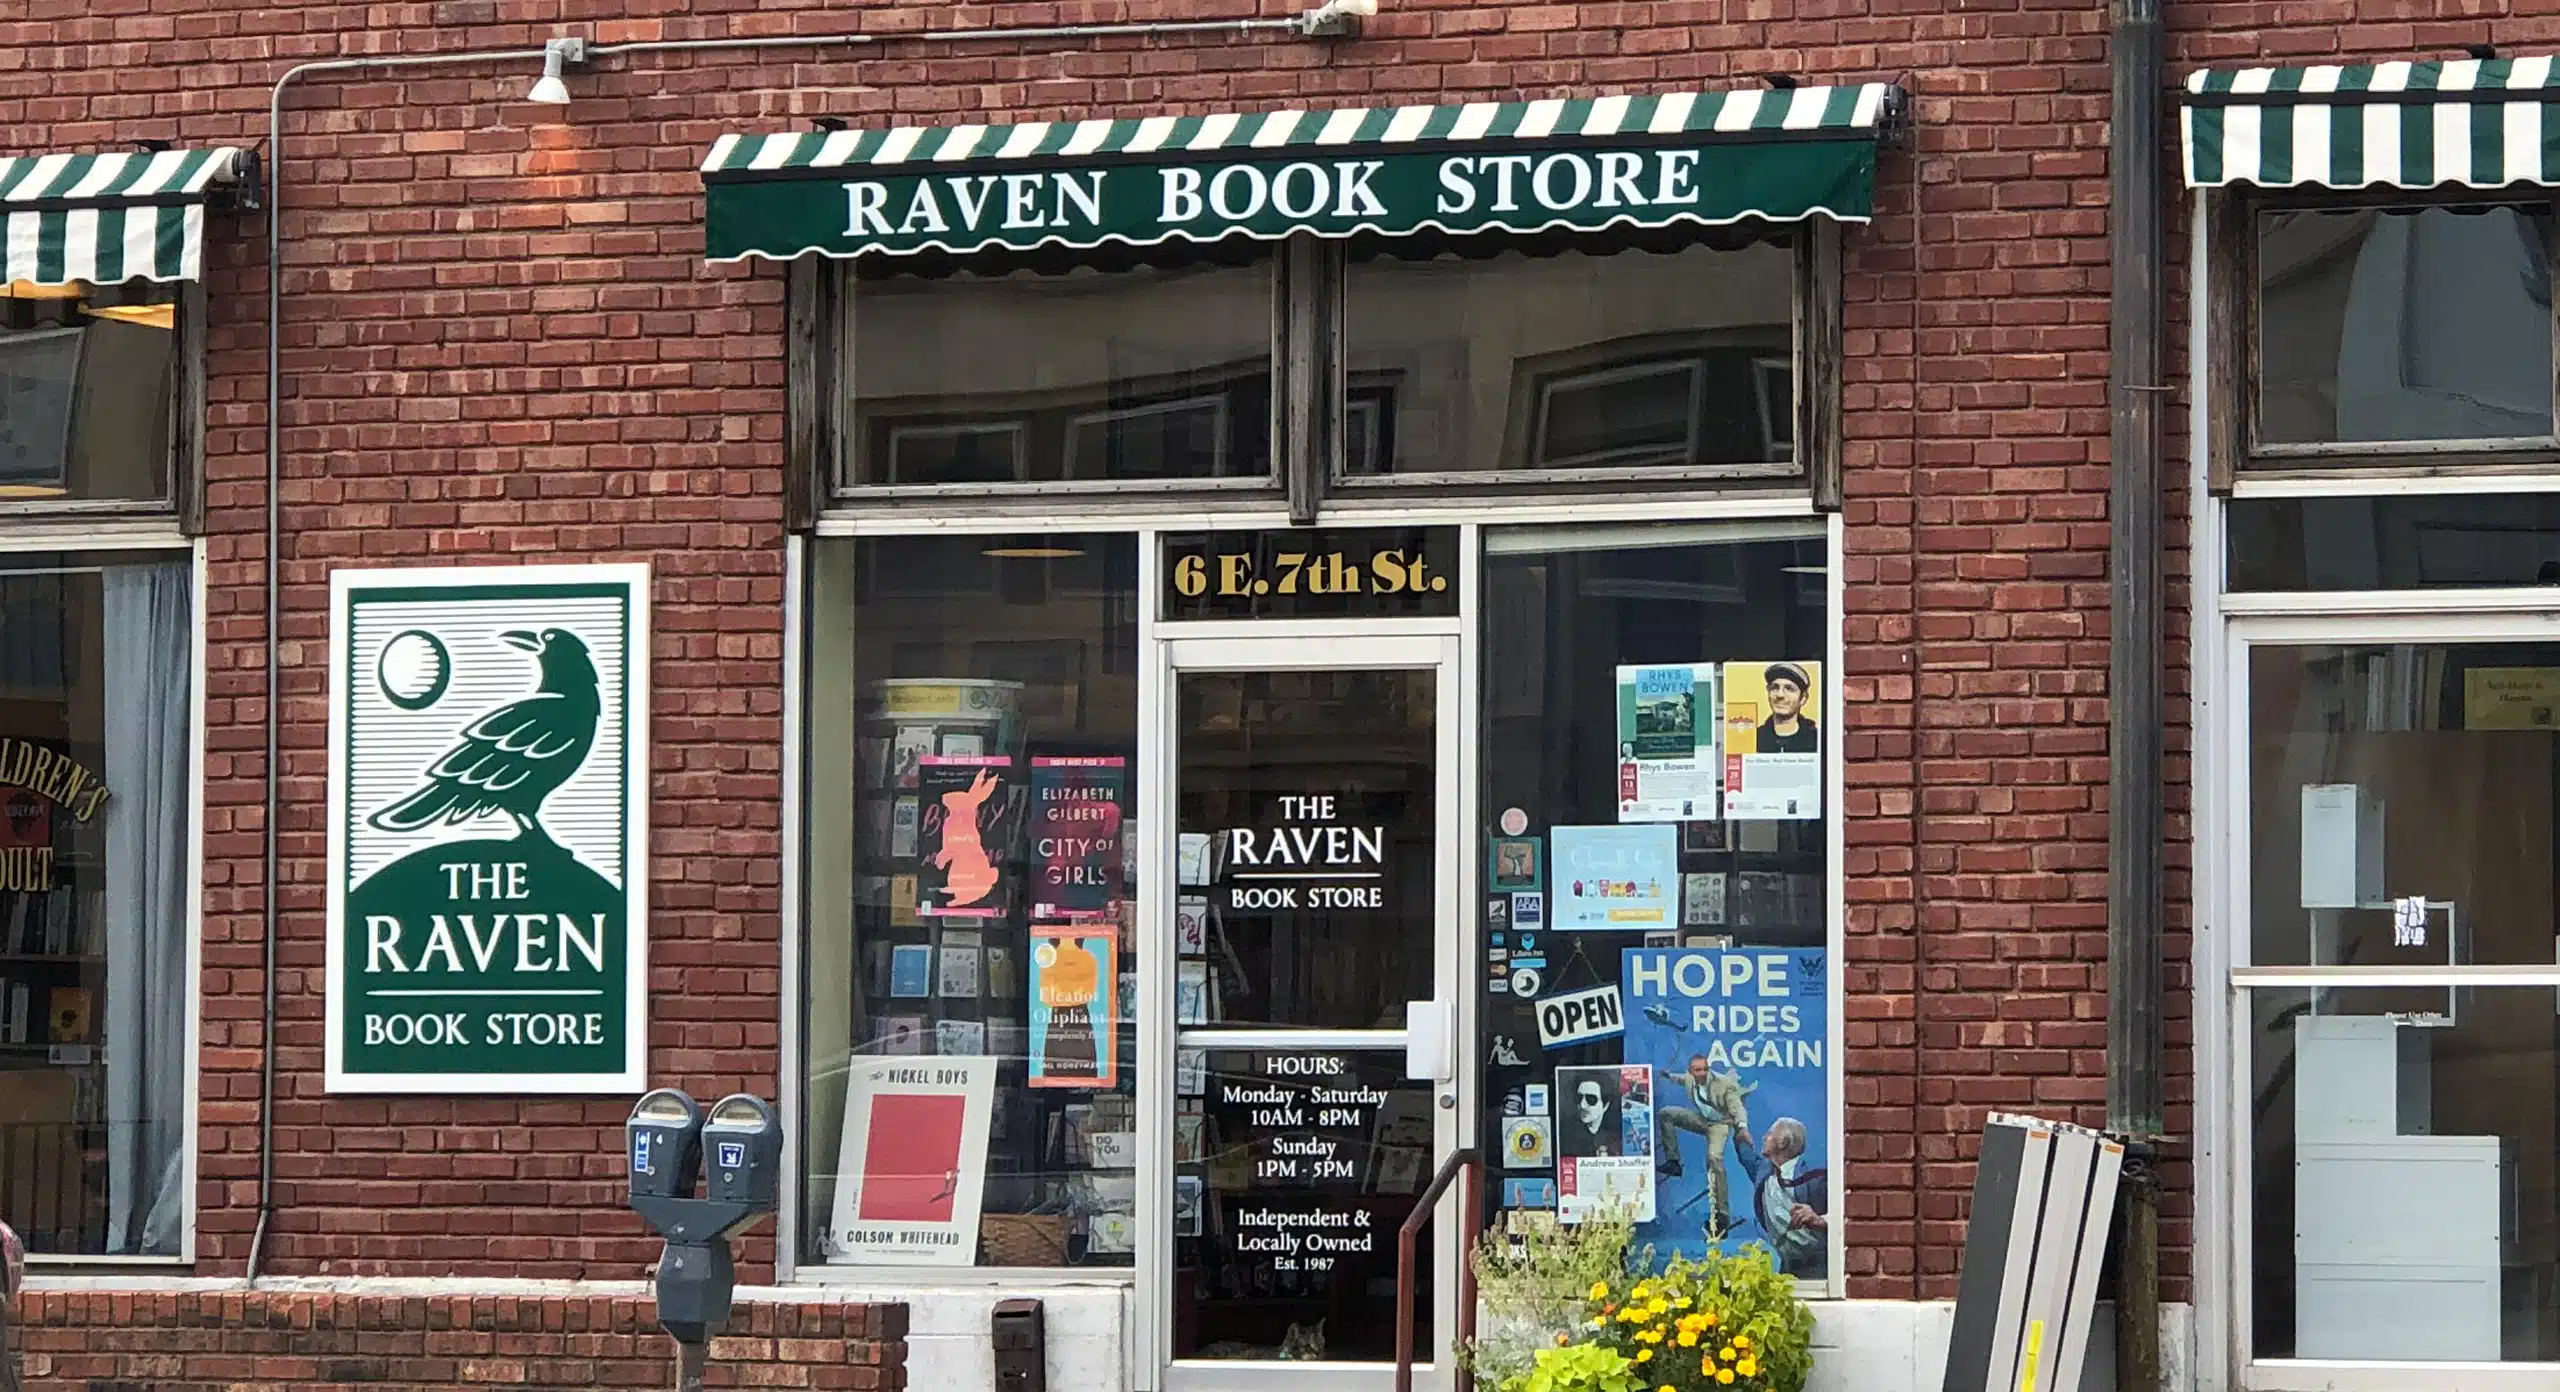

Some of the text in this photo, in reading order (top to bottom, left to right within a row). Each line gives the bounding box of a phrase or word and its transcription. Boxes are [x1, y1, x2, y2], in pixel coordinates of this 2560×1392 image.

[842, 149, 1700, 237] RAVEN BOOK STORE
[1174, 555, 1207, 596] 6
[1275, 552, 1361, 594] 7th
[1371, 548, 1446, 595] St.
[1649, 669, 1681, 680] RHYS
[1642, 682, 1688, 693] BOWEN
[1042, 787, 1114, 800] ELIZABETH
[1047, 807, 1106, 820] GILBERT
[1278, 796, 1337, 820] THE
[1038, 838, 1090, 857] CITY
[1231, 826, 1384, 865] RAVEN
[439, 862, 530, 899] THE
[1046, 866, 1108, 885] GIRLS
[1231, 887, 1383, 909] BOOK STORE
[364, 913, 606, 973] RAVEN
[1632, 954, 1790, 998] HOPE
[1039, 986, 1098, 1003] Eleanor
[1543, 992, 1619, 1038] OPEN
[1693, 1005, 1801, 1033] RIDES
[364, 1012, 605, 1045] BOOK STORE
[1708, 1039, 1822, 1068] AGAIN
[1266, 1056, 1345, 1075] HOURS:
[888, 1069, 930, 1084] NICKEL
[936, 1070, 968, 1084] BOYS
[1223, 1085, 1295, 1108] Monday
[1310, 1085, 1389, 1109] Saturday
[1252, 1109, 1304, 1126] 10AM
[1319, 1109, 1361, 1126] 8PM
[1095, 1136, 1112, 1145] DO
[1097, 1145, 1120, 1154] YOU
[1272, 1136, 1337, 1160] Sunday
[1257, 1160, 1297, 1177] 1PM
[1313, 1160, 1354, 1178] 5PM
[1580, 1158, 1616, 1168] Andrew
[1238, 1208, 1371, 1232] Independent &
[847, 1230, 960, 1245] COLSON WHITEHEAD
[1238, 1233, 1372, 1256] Locally Owned
[1274, 1256, 1335, 1271] Est. 1987
